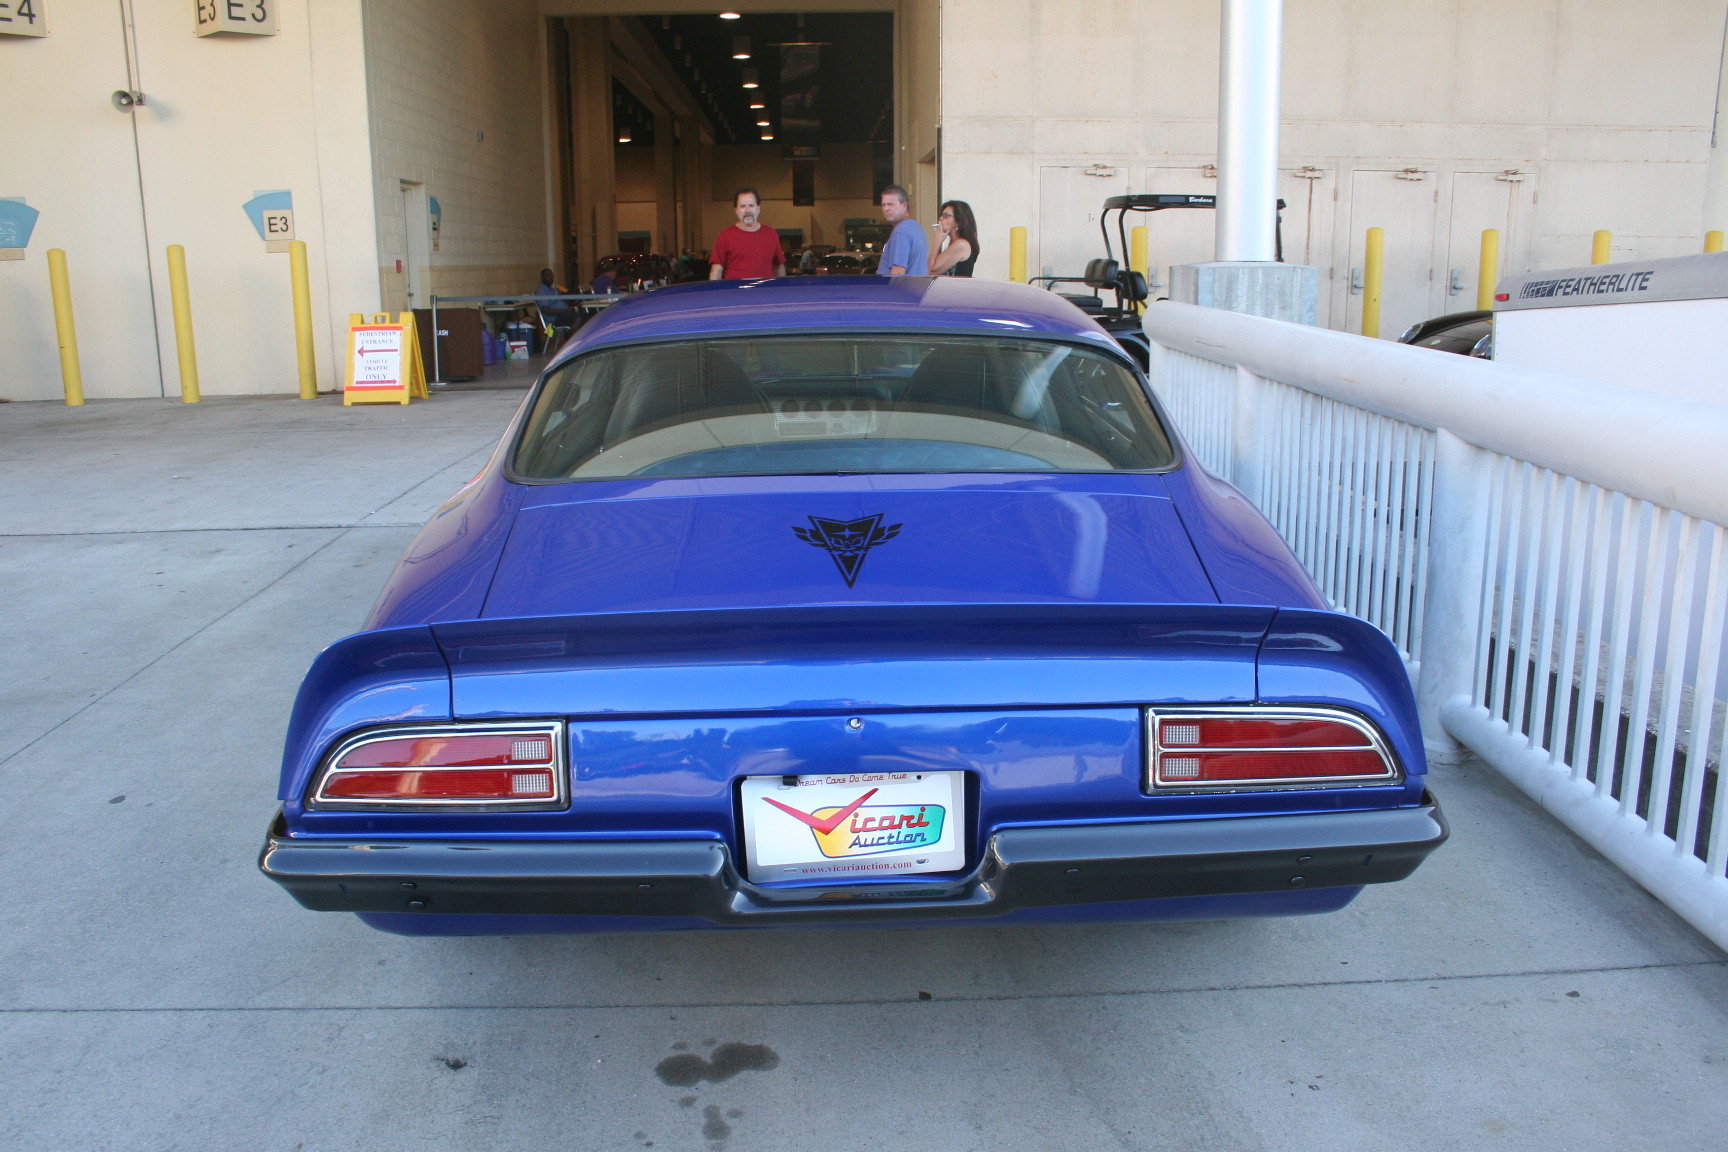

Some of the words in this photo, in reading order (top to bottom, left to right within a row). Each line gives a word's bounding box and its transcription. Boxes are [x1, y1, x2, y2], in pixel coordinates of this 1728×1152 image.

[197, 0, 217, 24] E3
[227, 0, 267, 23] E3
[267, 216, 289, 233] E3
[1554, 270, 1654, 297] FEATHERLITE
[826, 776, 847, 785] Cars
[849, 774, 860, 783] Do
[862, 773, 885, 782] Come
[887, 771, 908, 780] True
[848, 830, 927, 849] Auction
[801, 860, 913, 874] www.vicariauction.com
